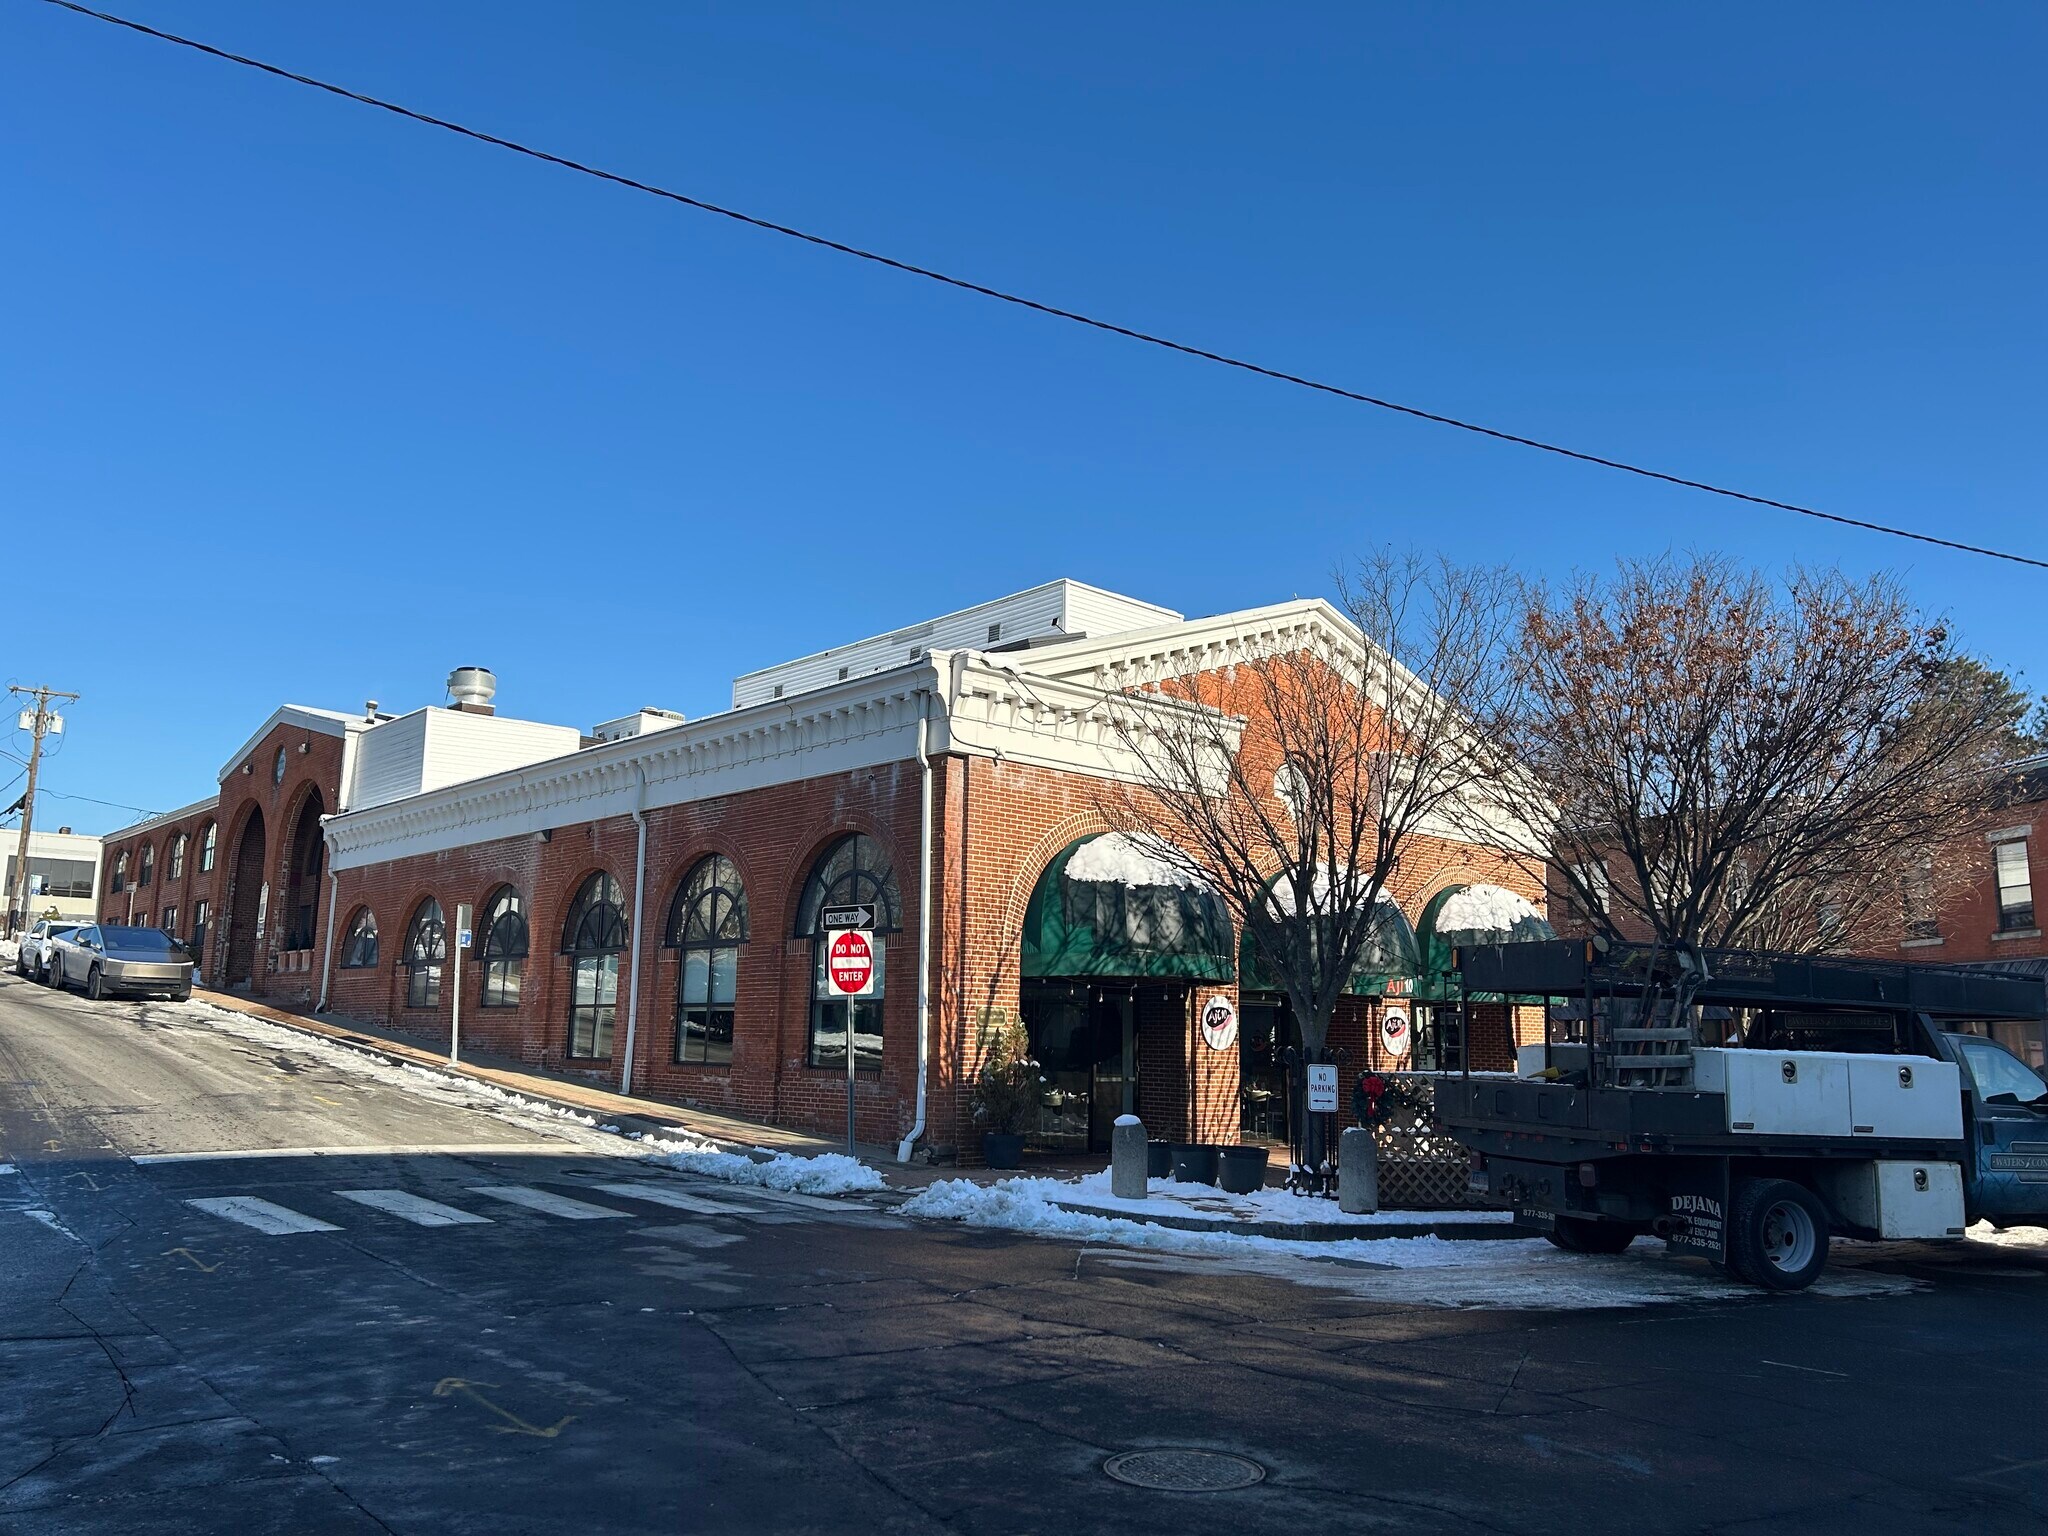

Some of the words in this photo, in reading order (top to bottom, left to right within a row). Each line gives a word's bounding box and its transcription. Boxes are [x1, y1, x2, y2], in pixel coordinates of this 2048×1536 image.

[828, 915, 843, 924] ONE
[844, 913, 859, 922] WAY
[835, 944, 847, 954] DO
[850, 944, 866, 954] NOT
[838, 972, 863, 982] ENTER
[1318, 1072, 1327, 1082] NO
[1310, 1083, 1336, 1094] PARKING
[1995, 1157, 2025, 1167] WATERS
[1671, 1195, 1722, 1220] DEJANA
[1693, 1216, 1722, 1230] EQUIPMENT
